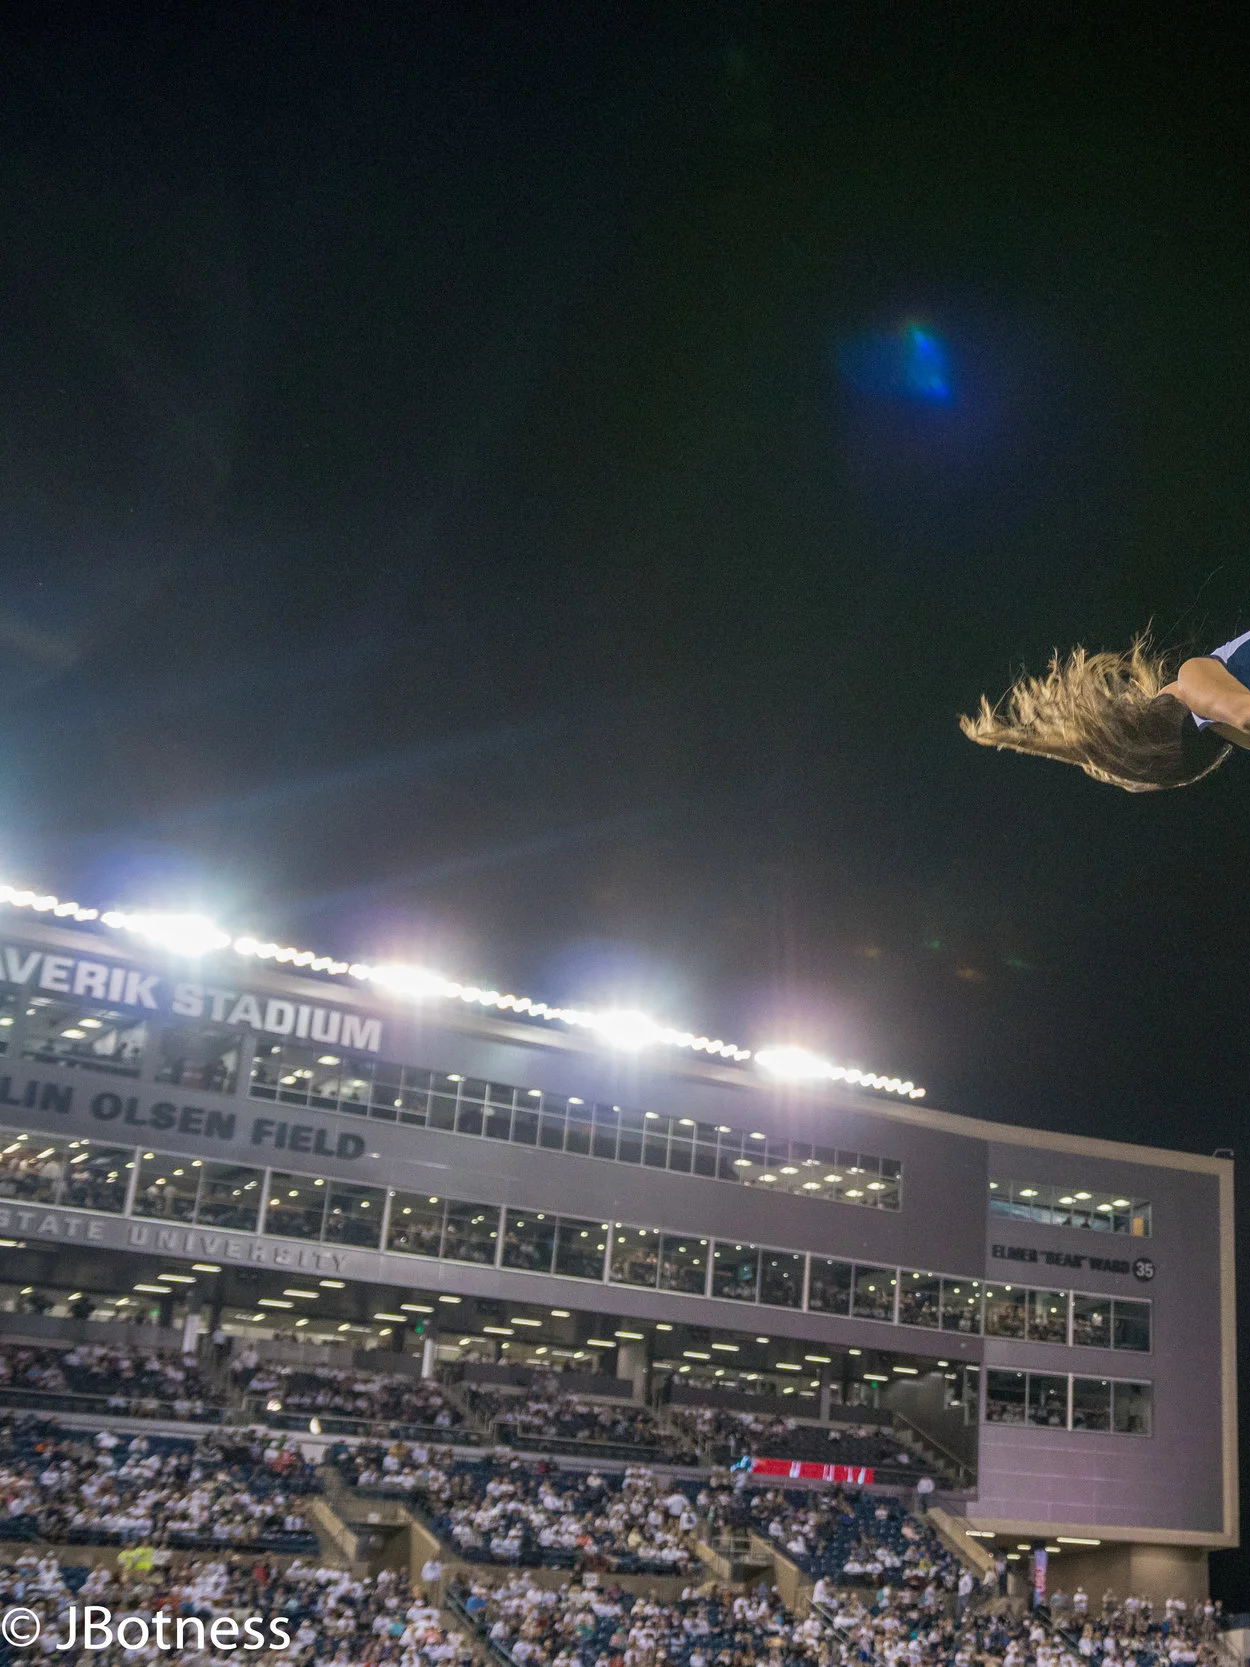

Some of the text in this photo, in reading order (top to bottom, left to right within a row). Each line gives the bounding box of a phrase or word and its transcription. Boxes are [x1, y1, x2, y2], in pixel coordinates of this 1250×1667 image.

[0, 947, 382, 1052] VERIK STADIUM
[90, 1093, 236, 1140] OLSEN
[251, 1118, 367, 1160] FIELD
[0, 1207, 348, 1273] STATE UNIVERSITY
[1137, 1261, 1153, 1278] 35
